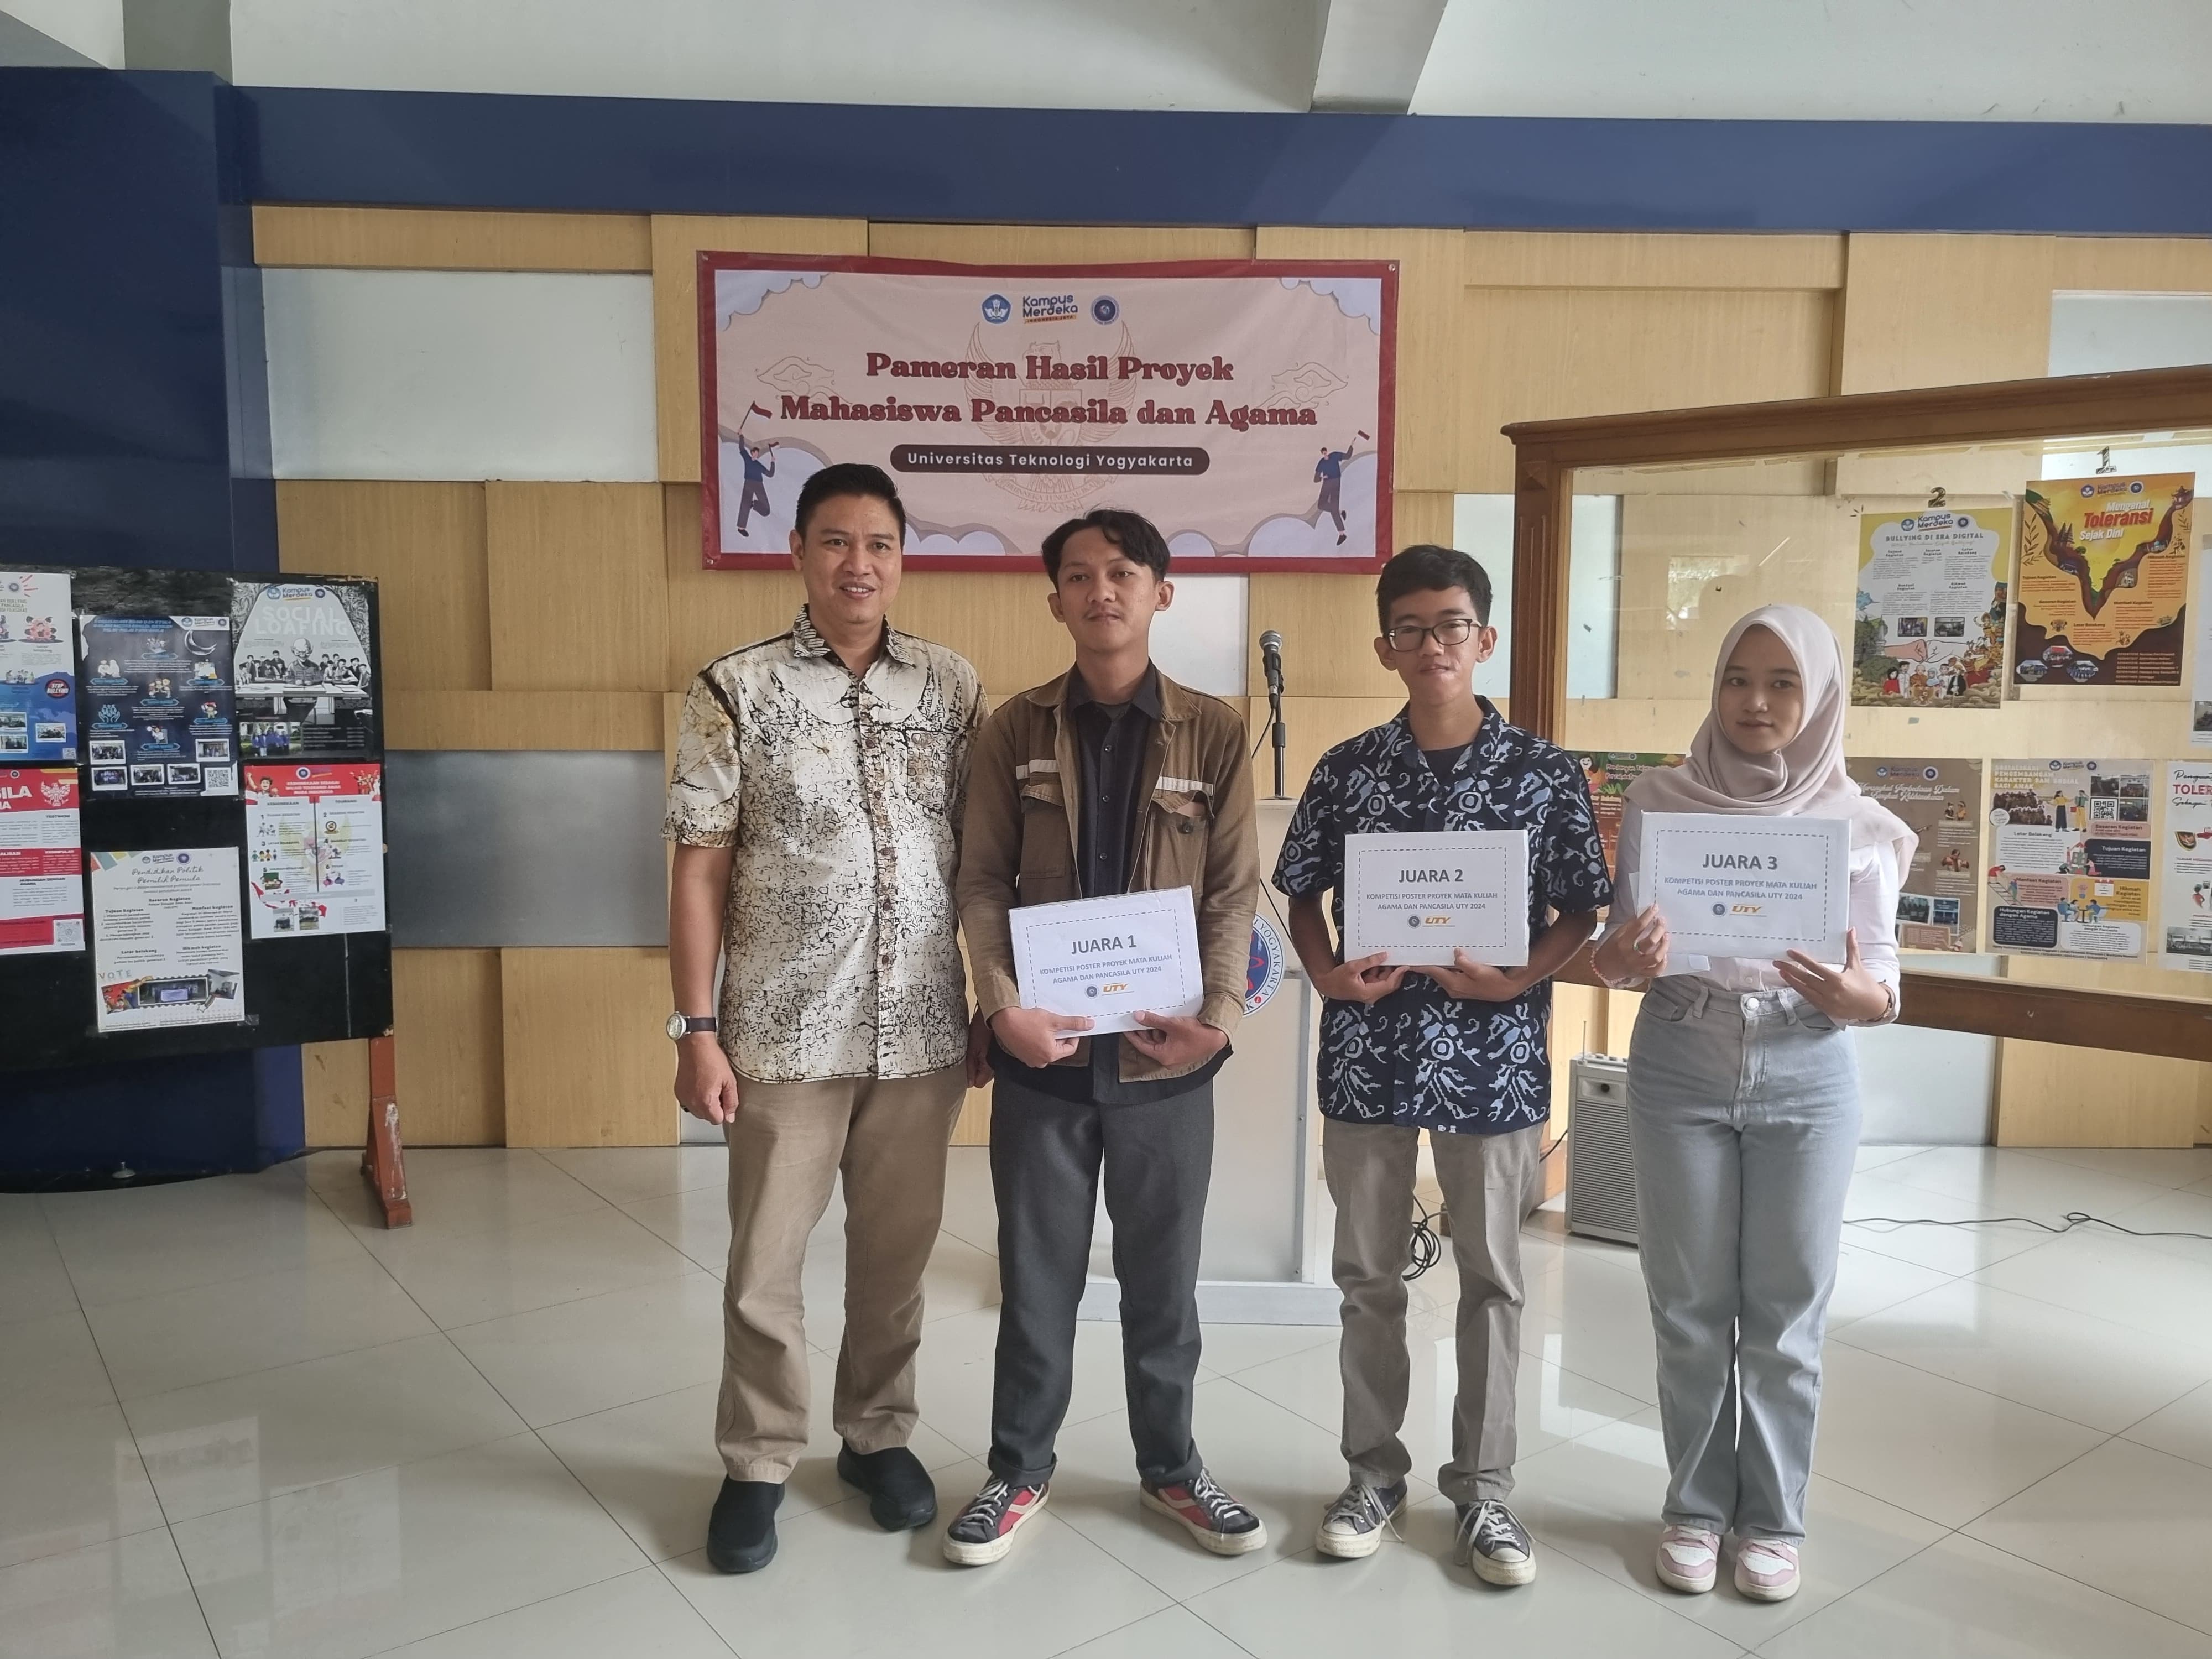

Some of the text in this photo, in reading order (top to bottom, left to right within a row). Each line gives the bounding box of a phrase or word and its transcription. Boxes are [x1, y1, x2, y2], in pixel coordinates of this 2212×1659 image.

[1023, 295, 1073, 308] Kampus
[1023, 304, 1078, 318] Merdeka
[866, 352, 1234, 387] Pameran Hasil Proyek
[781, 395, 1318, 432] Mahasiswa Pancasila dan Agama
[907, 452, 1193, 470] Universitas Teknologi Yogyakarta
[2096, 446, 2117, 474] 1
[1928, 487, 1946, 508] 2
[2106, 499, 2150, 512] Mengenal
[1918, 514, 1951, 523] Kampus
[1918, 519, 1953, 529] Merdeka
[2084, 507, 2154, 528] Toleransi
[2080, 528, 2124, 541] Sejak Dini
[262, 606, 341, 622] SOCIAL
[255, 619, 348, 636] LOAFING
[1702, 853, 1778, 870] JUARA 3
[170, 875, 201, 883] Pemula
[1398, 869, 1464, 883] JUARA 2
[1664, 877, 1817, 890] KOMPETISI POSTER PROYEK MATA KULIAH
[1725, 890, 1766, 899] PANCASILA
[1784, 892, 1803, 900] 2024
[1731, 905, 1762, 914] UTY
[1071, 935, 1137, 955] JUARA 1
[1040, 954, 1172, 975] KOMPETISI POSTER PROYEK MATA KULIAH
[1260, 923, 1281, 997] YOGYAKARTA
[98, 969, 133, 980] VOTE
[1053, 975, 1078, 984] AGAMA
[1095, 970, 1131, 979] PANCASILA
[1146, 966, 1162, 974] 2024
[1103, 983, 1129, 993] UTY
